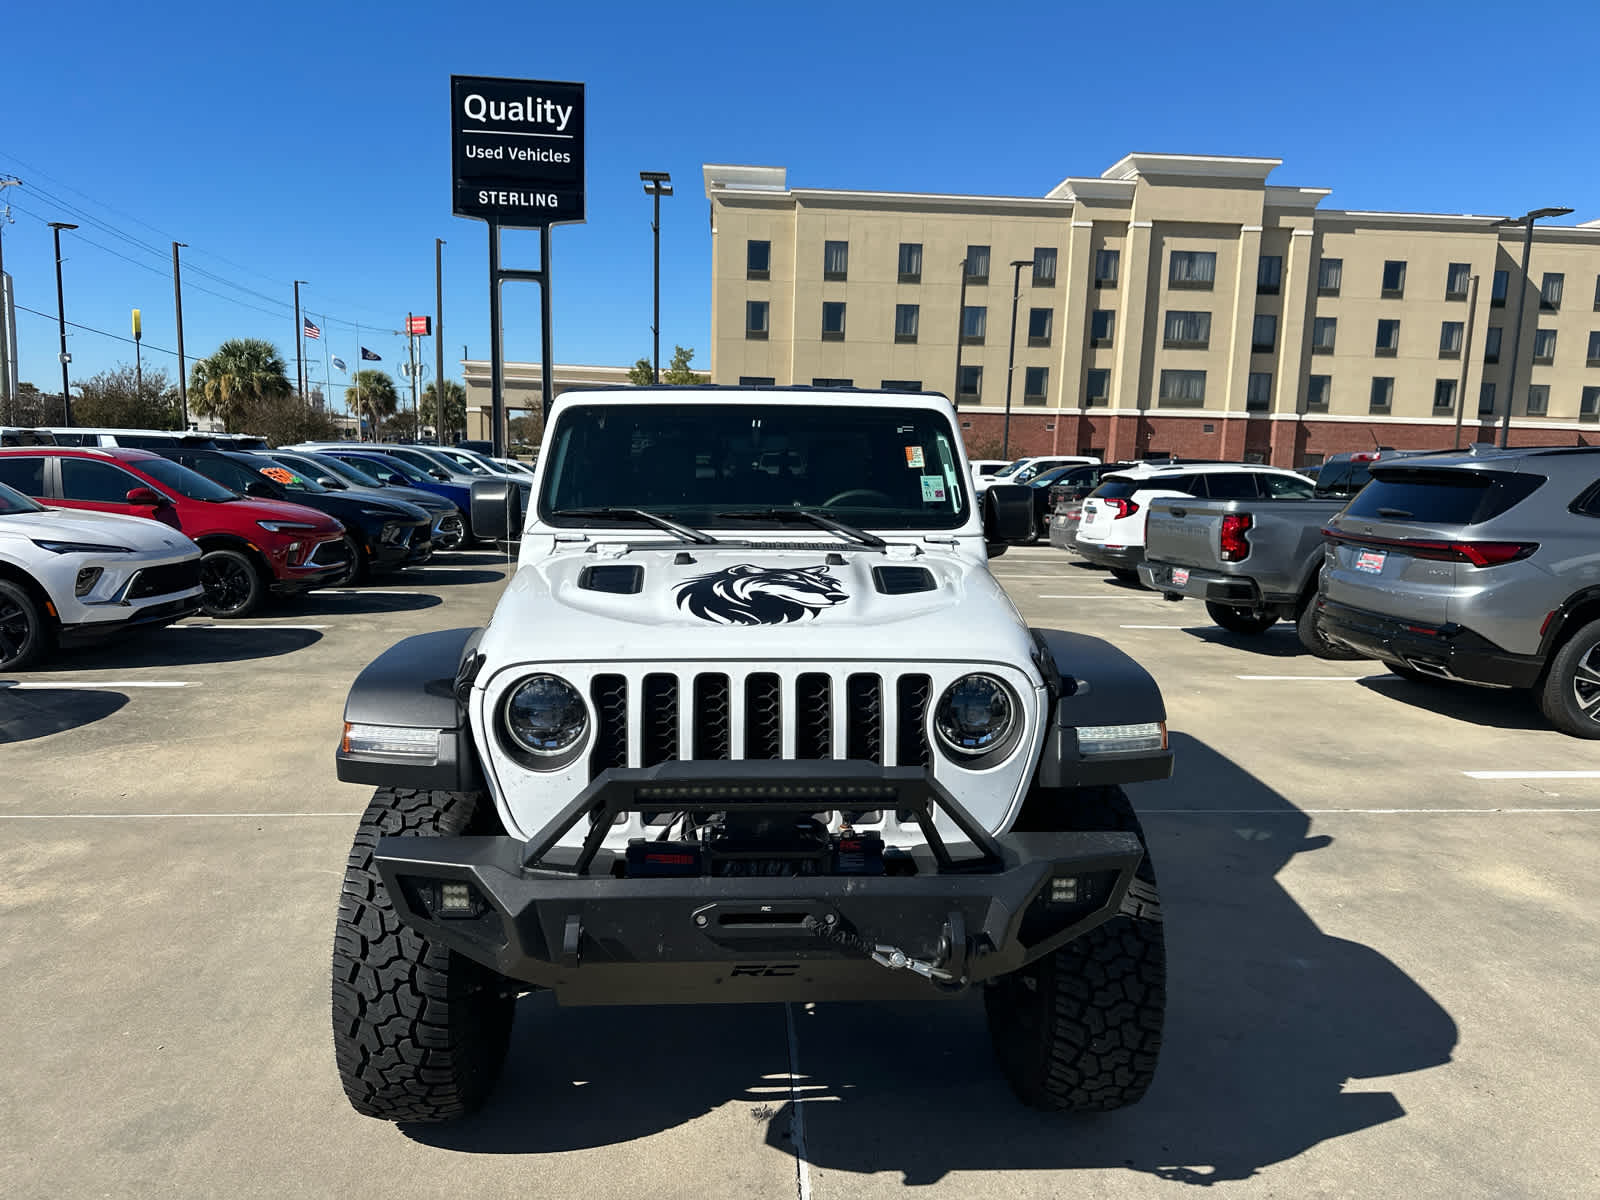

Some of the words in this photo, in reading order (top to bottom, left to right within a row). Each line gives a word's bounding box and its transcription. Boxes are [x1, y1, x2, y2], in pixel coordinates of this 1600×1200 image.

[464, 94, 573, 131] Quality
[466, 145, 503, 159] Used
[508, 147, 571, 163] Vehicles
[478, 191, 558, 207] STERLING
[730, 965, 801, 977] RC
